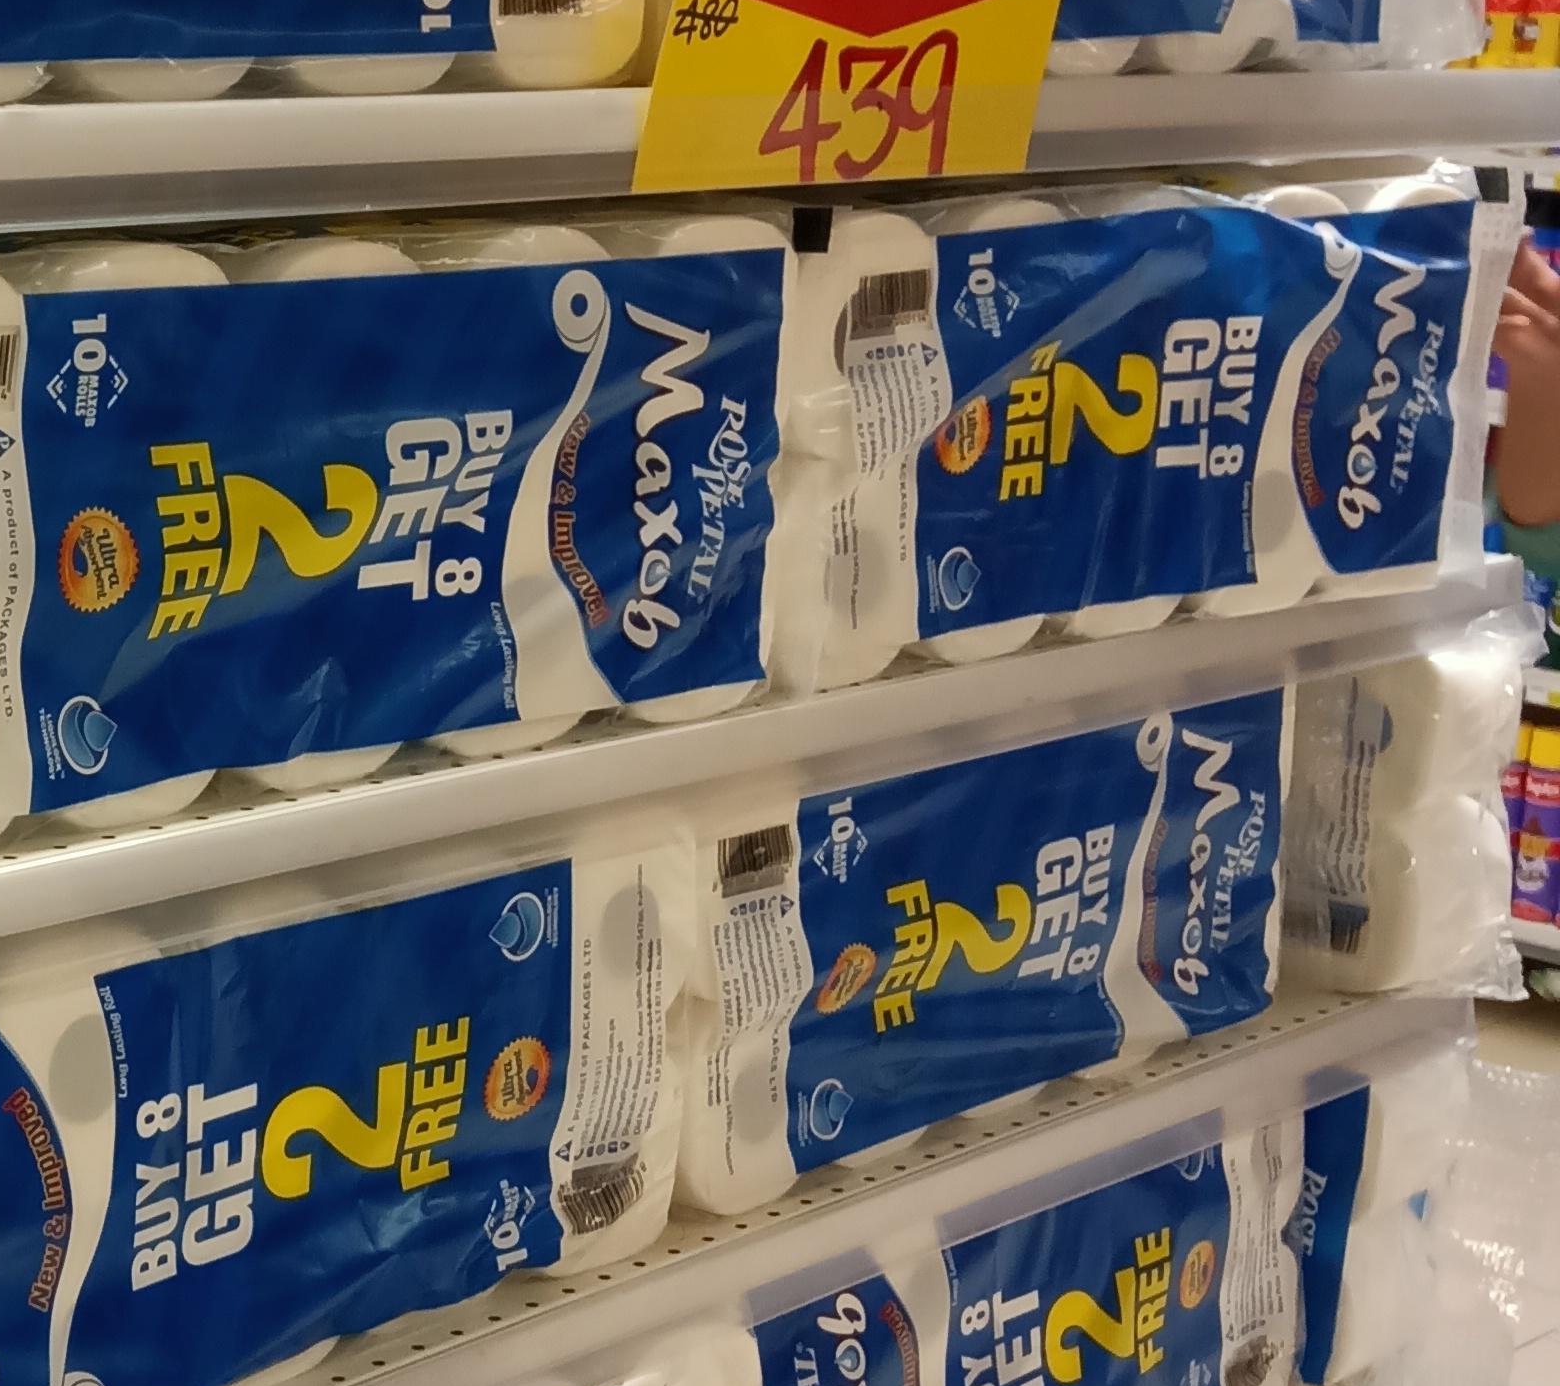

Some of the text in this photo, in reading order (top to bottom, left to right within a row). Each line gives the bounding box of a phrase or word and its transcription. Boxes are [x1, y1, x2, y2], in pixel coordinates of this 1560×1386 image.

[759, 28, 960, 184] 439
[72, 313, 107, 373] 10
[75, 375, 86, 417] ROLLS
[84, 375, 100, 428] MAXOB
[1049, 354, 1159, 467] 2
[1155, 317, 1223, 480] GET
[1214, 316, 1263, 425] BUY
[1, 470, 12, 481] A
[2, 487, 20, 556] product
[147, 440, 221, 641] FREE
[220, 463, 379, 598] 2
[357, 416, 464, 603] GET
[434, 409, 514, 599] BUY 8
[550, 412, 611, 630] New Improved
[687, 463, 729, 598] PETAL
[8, 564, 19, 580] of
[95, 527, 120, 589] Ultra
[916, 881, 1037, 991] 2
[1018, 836, 1083, 981] GET
[1082, 824, 1115, 927] BUY
[873, 878, 938, 1033] FREE
[261, 1061, 408, 1201] 2
[398, 1016, 472, 1193] FREE
[2, 1086, 70, 1313] New Improved
[131, 1092, 183, 1292] BUY 8
[181, 1081, 260, 1269] GET
[1044, 1264, 1137, 1384] 2
[1133, 1226, 1171, 1374] FREE
